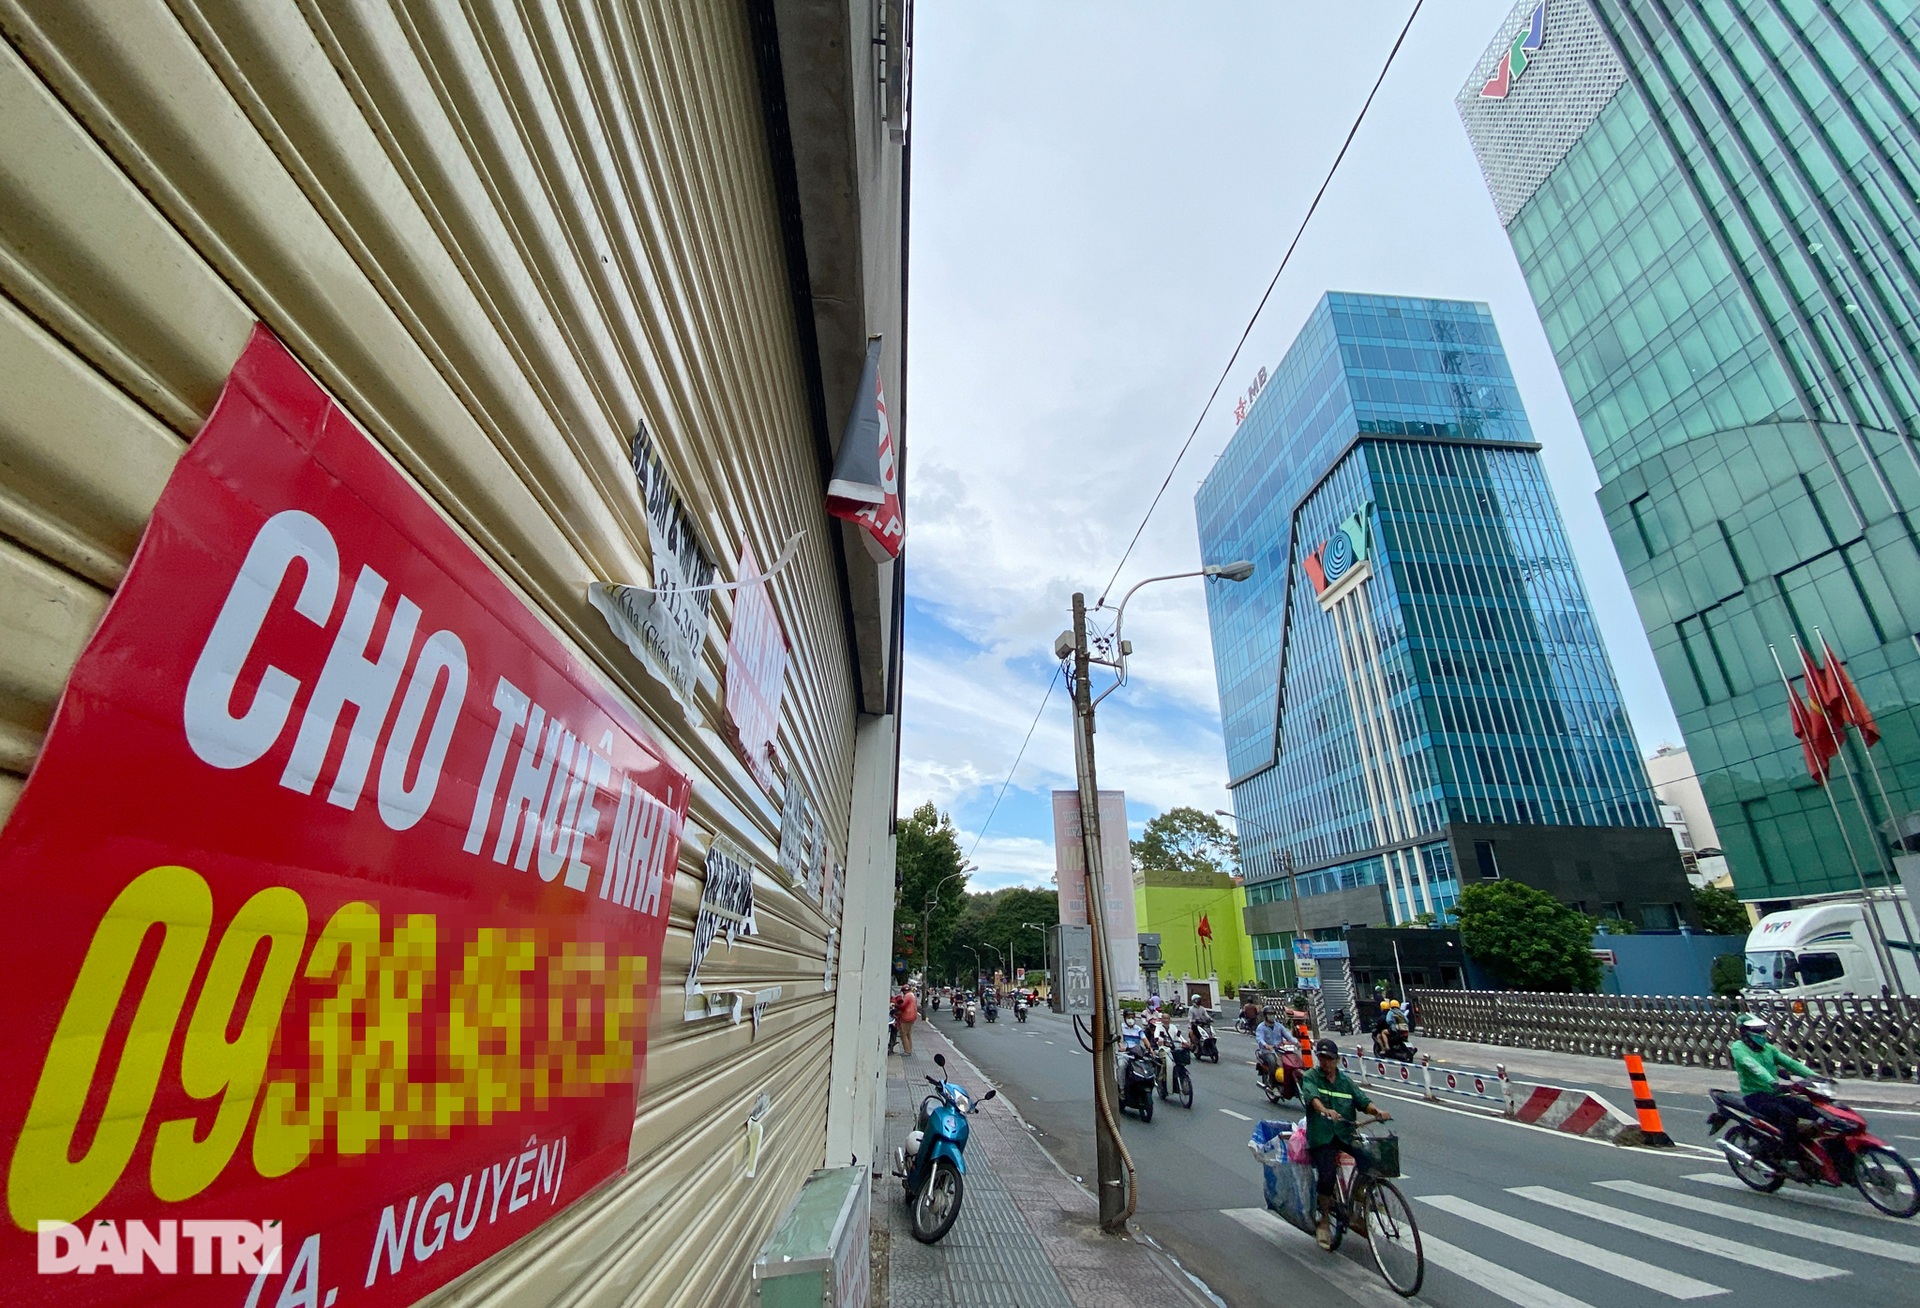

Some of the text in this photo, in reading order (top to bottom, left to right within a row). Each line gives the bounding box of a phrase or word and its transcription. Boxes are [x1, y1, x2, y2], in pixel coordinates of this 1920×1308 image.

[1247, 366, 1268, 404] MB
[184, 509, 468, 832] CHO
[462, 676, 613, 885] THUÊ
[600, 777, 673, 917] NHÀ
[1763, 920, 1793, 934] VTV9
[364, 1134, 568, 1288] NGUYÊN)
